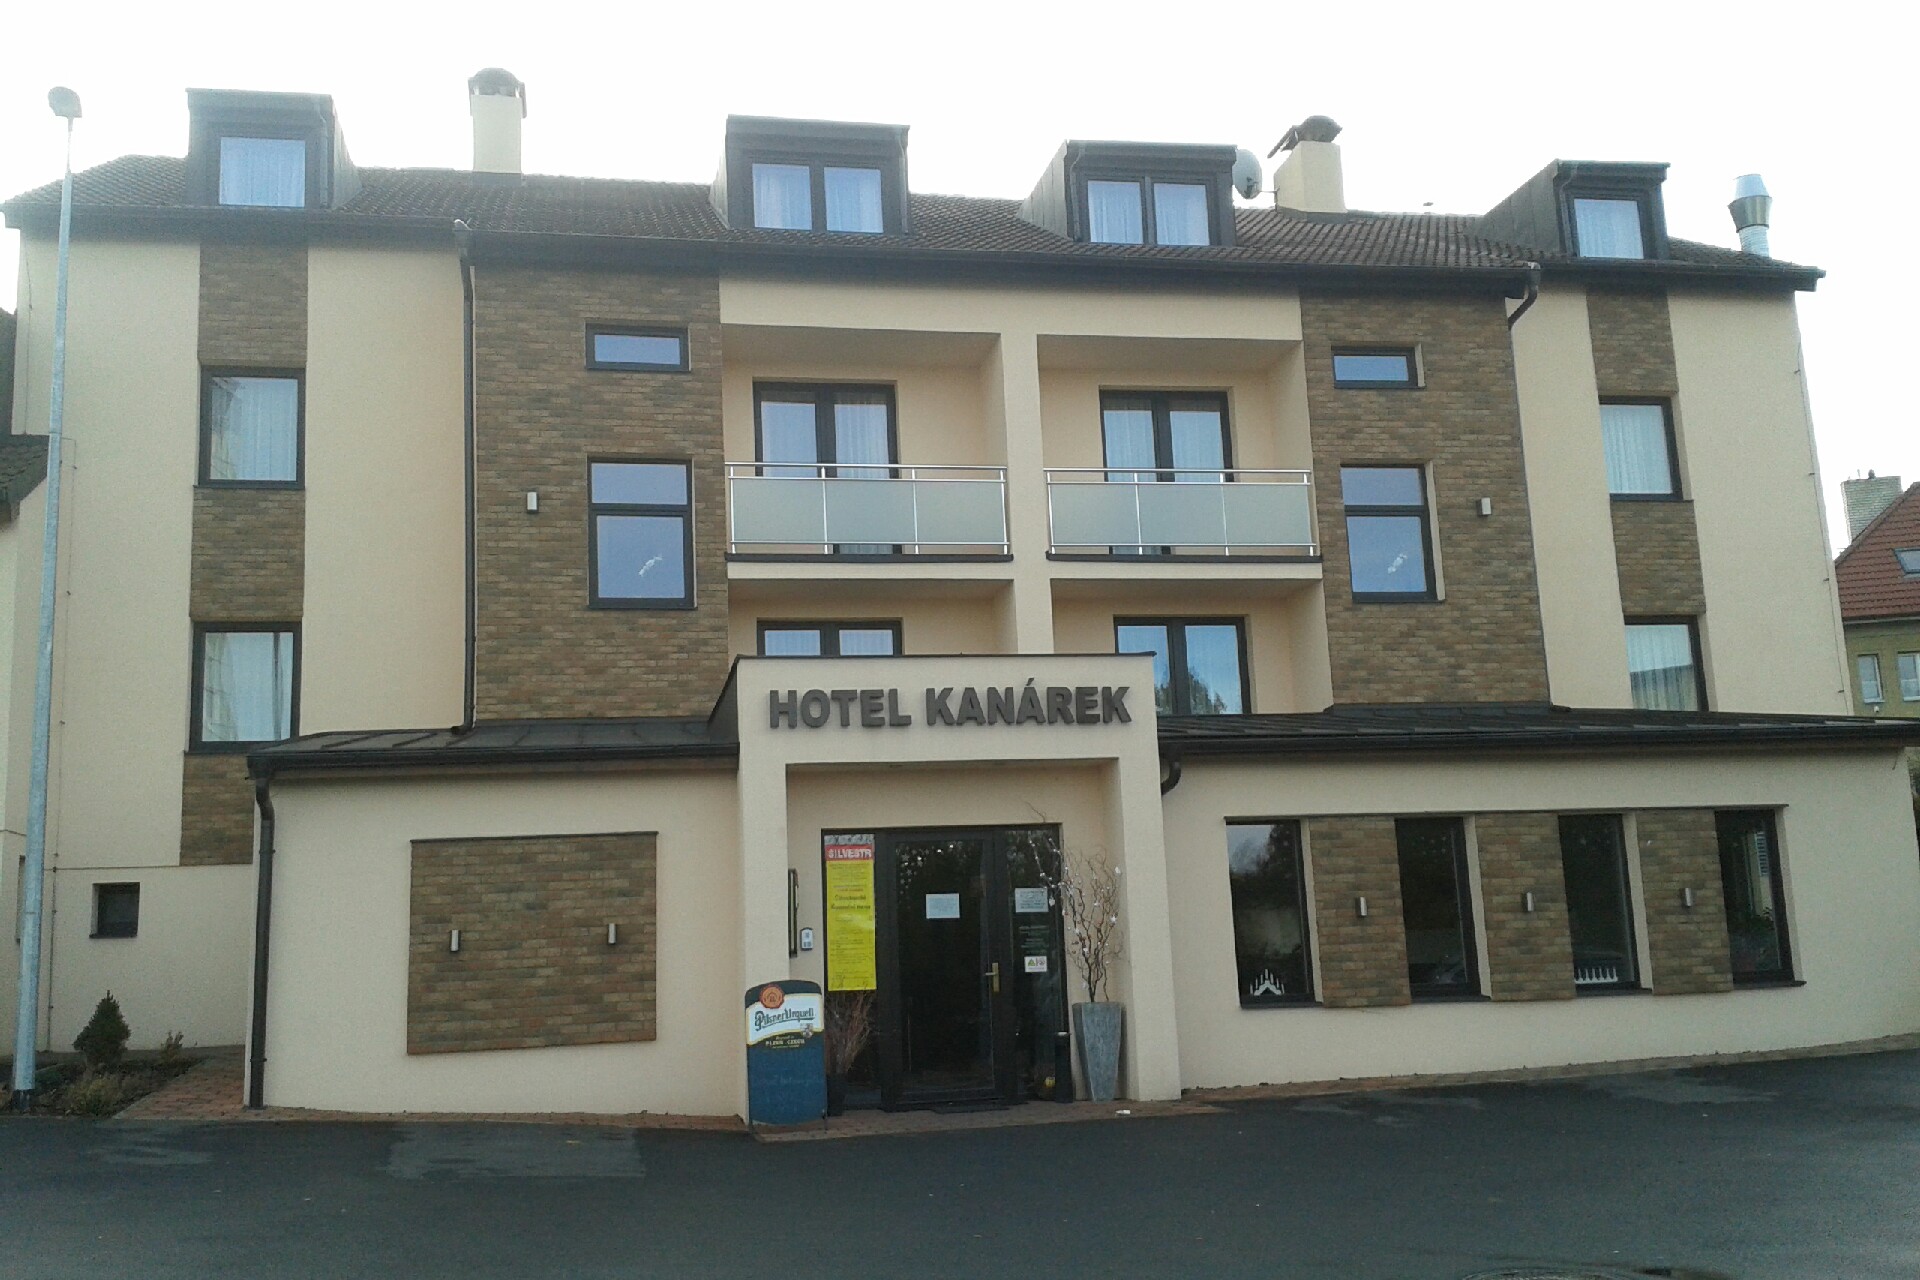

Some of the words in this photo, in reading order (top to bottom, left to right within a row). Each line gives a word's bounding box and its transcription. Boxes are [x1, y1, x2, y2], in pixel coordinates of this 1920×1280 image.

[770, 689, 912, 728] HOTEL
[925, 678, 1132, 726] KANÁREK
[828, 848, 872, 858] SILVESTR
[755, 1010, 784, 1032] Pilsner
[784, 1007, 814, 1022] Urquell
